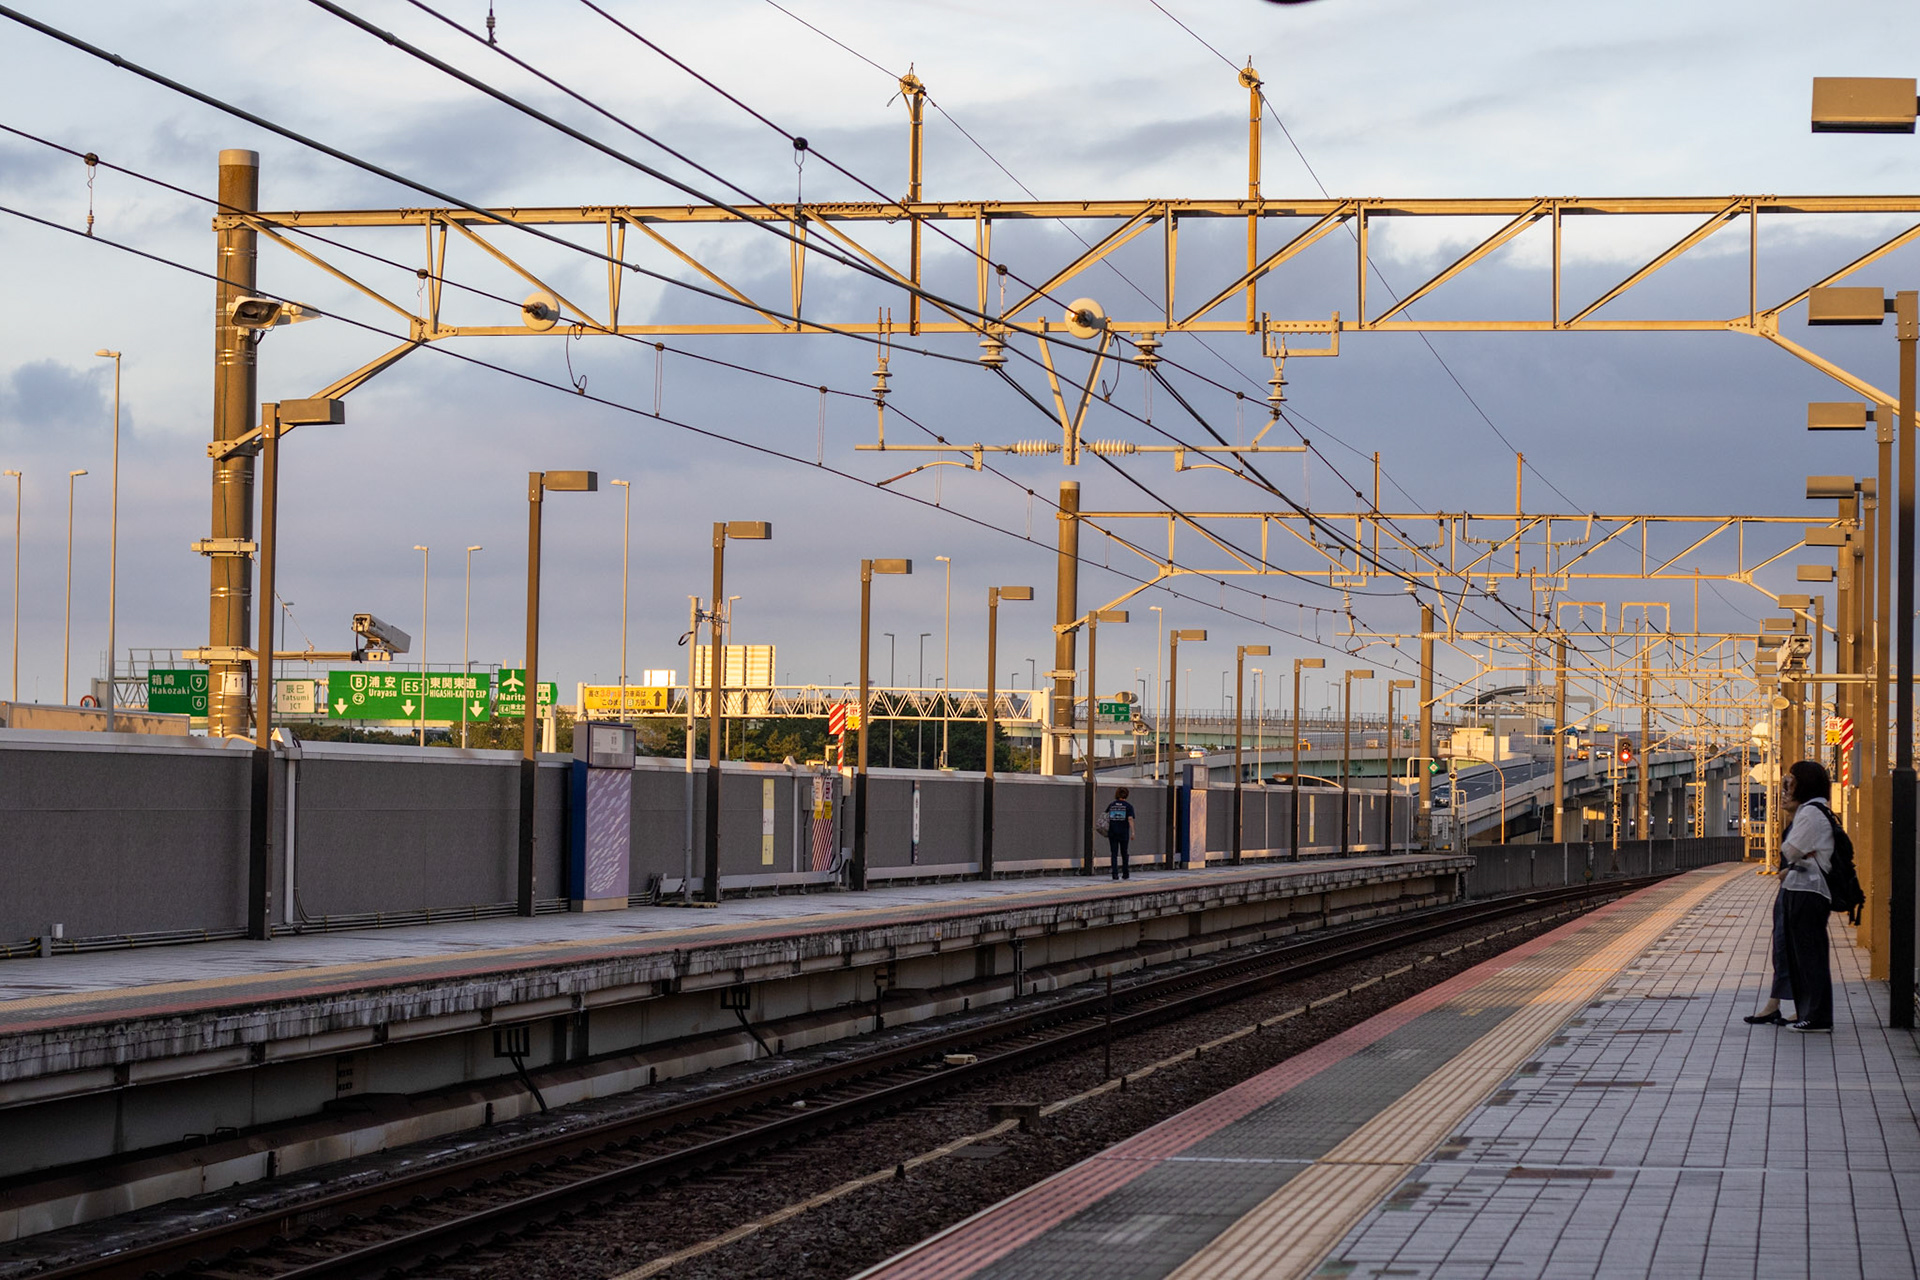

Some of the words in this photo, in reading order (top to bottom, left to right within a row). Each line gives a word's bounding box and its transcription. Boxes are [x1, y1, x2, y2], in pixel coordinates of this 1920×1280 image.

[152, 674, 174, 686] 箱崎
[196, 678, 202, 688] 9
[234, 678, 244, 688] 11
[355, 677, 362, 688] B
[368, 676, 396, 688] 浦安
[430, 677, 478, 689] 東関東道
[151, 686, 190, 694] Hakozaki
[368, 688, 398, 698] Urayasu
[430, 690, 474, 698] HIGASHI-KATO
[476, 690, 487, 698] EXP
[196, 698, 202, 707] 6
[500, 693, 526, 702] Narita
[1102, 704, 1109, 714] P
